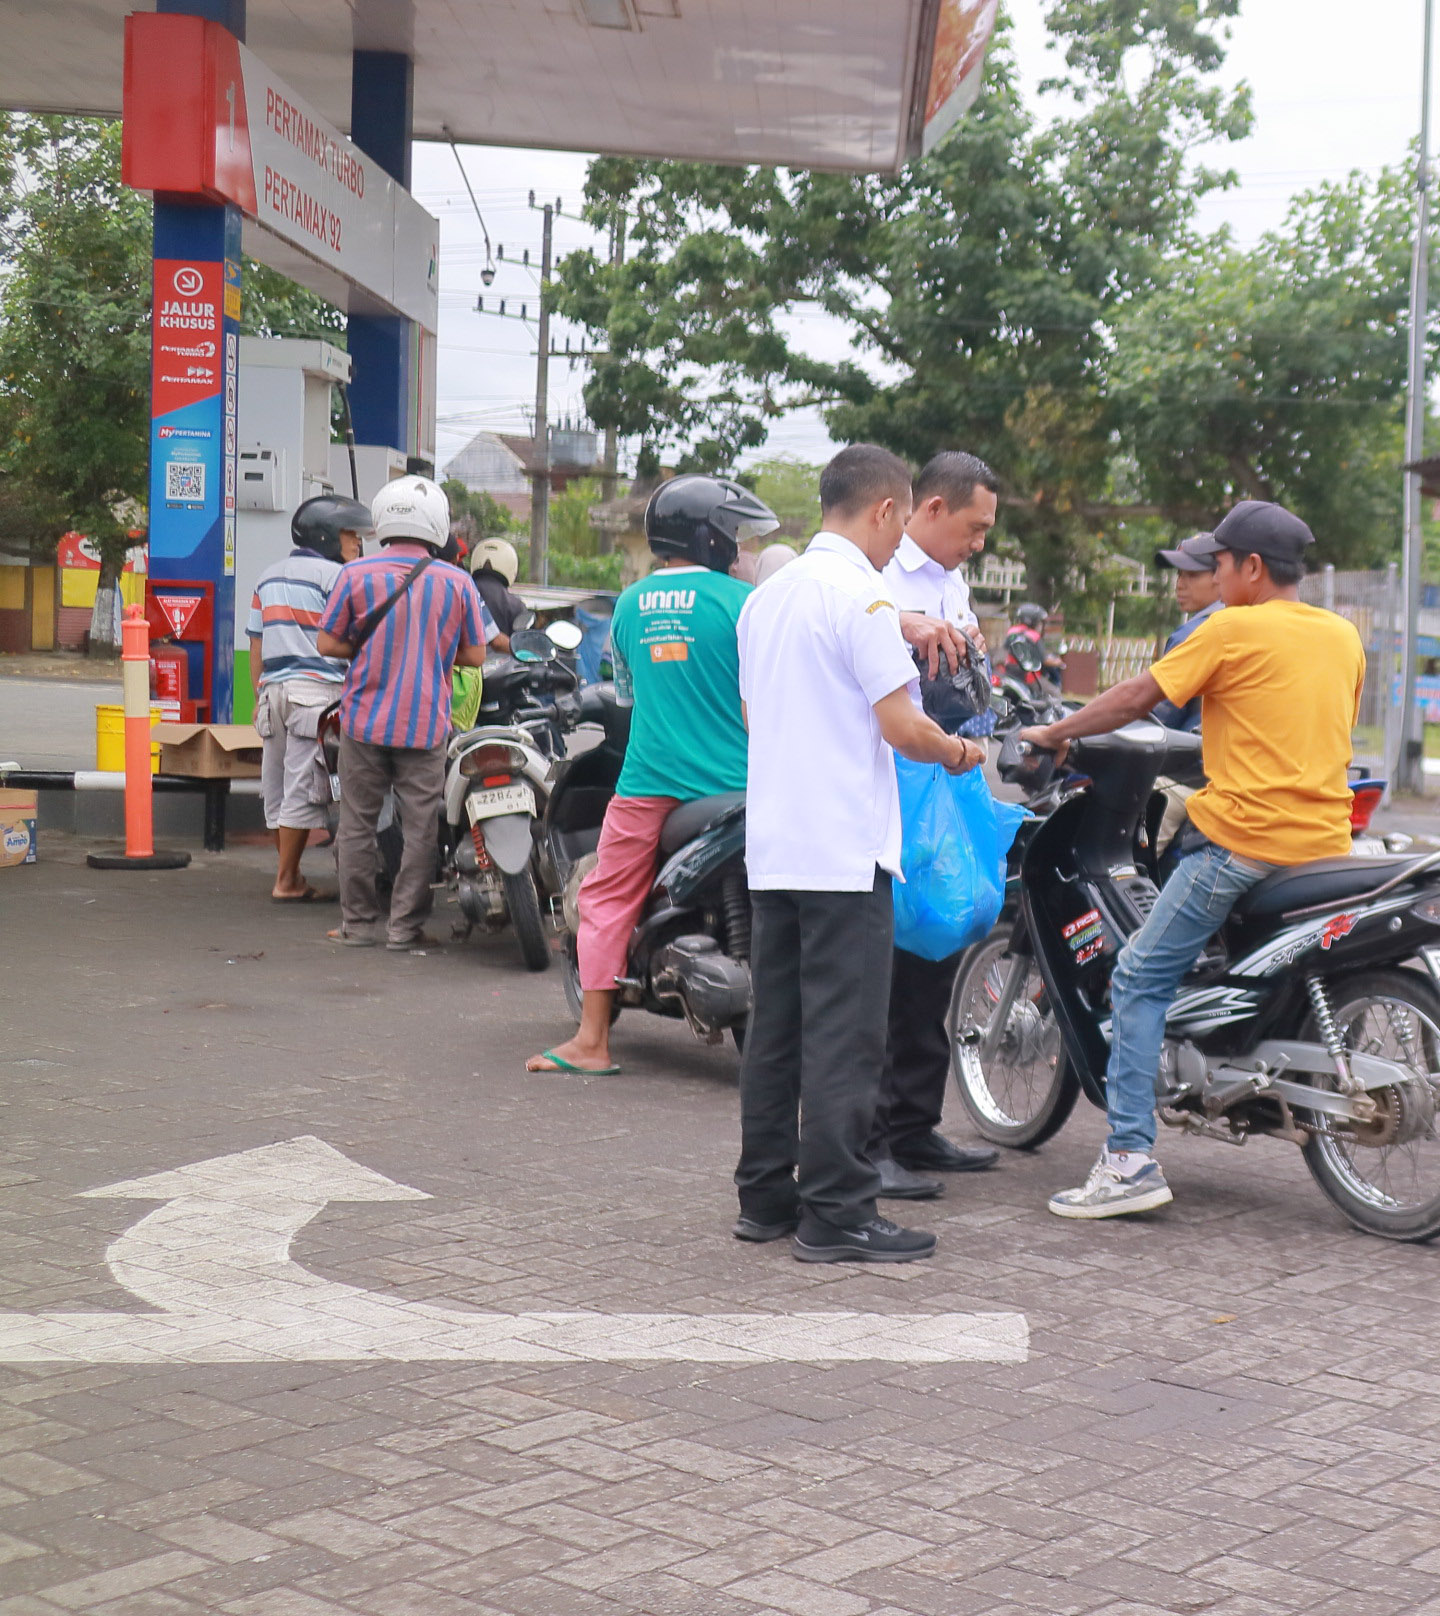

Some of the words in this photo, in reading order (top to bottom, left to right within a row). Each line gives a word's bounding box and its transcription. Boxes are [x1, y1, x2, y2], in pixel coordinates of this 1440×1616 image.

[226, 80, 236, 152] 1
[266, 87, 328, 171] PERTAMAX
[330, 141, 365, 200] TURBO
[264, 165, 327, 244] PERTAMAX
[160, 316, 215, 331] KHUSUS
[161, 301, 215, 318] JALUR
[161, 375, 214, 384] PERTAMAX
